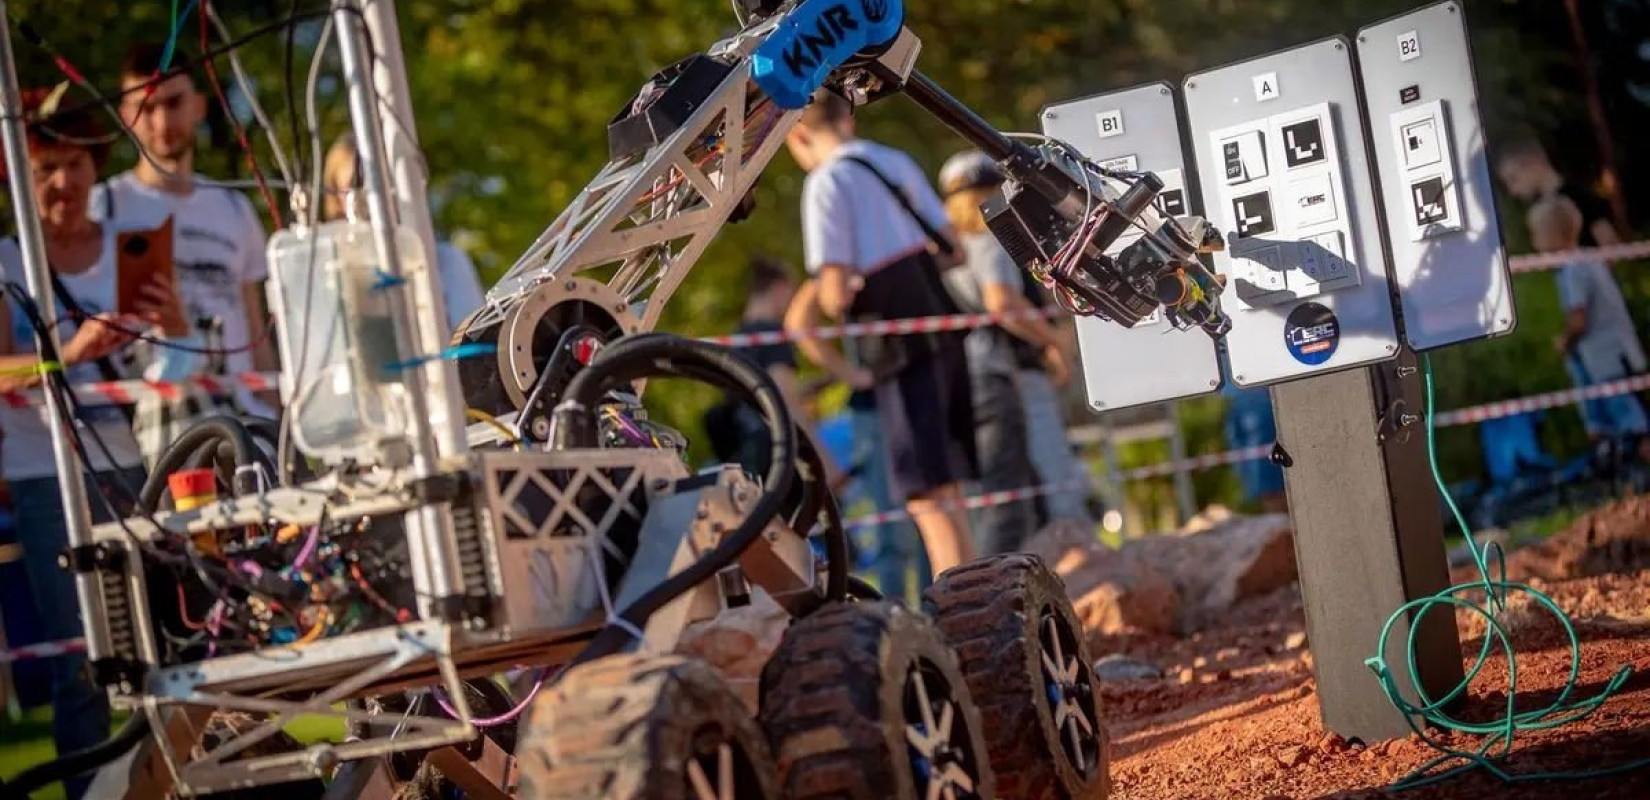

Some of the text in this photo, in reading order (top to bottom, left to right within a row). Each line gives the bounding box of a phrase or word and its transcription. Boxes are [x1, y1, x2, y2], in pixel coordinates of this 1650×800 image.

[781, 4, 858, 78] KNR
[1401, 38, 1417, 55] B2
[1262, 80, 1272, 95] A
[1102, 117, 1118, 132] B1
[1227, 165, 1240, 175] OFF
